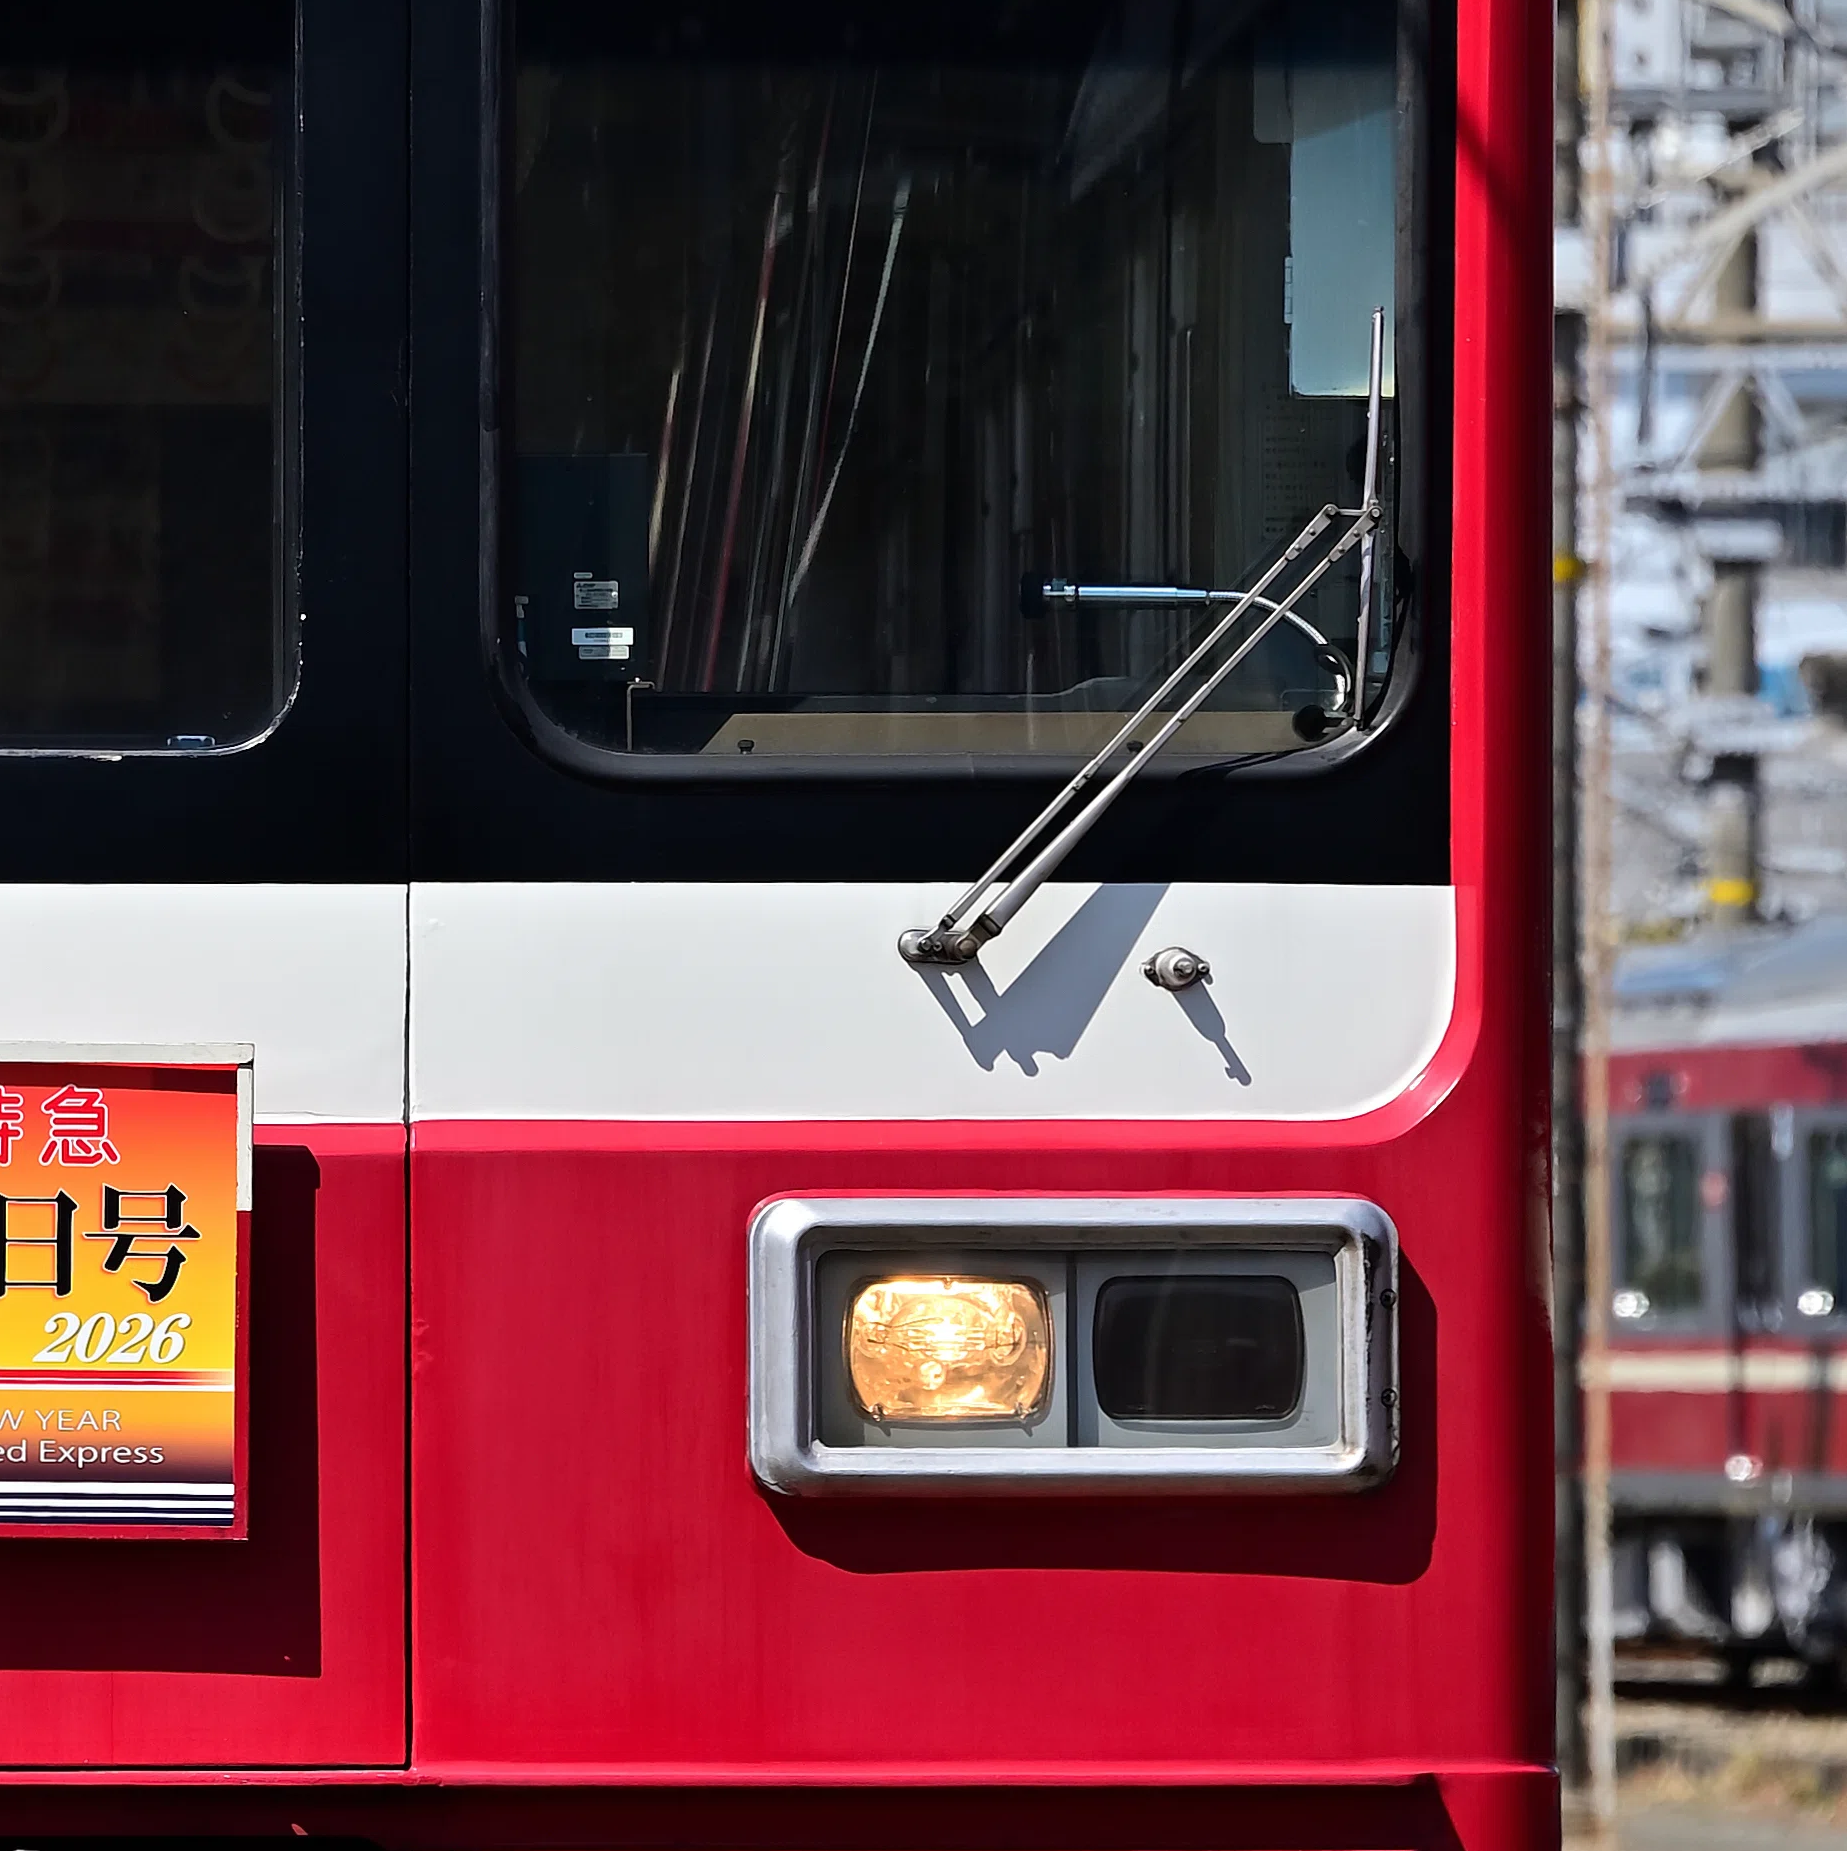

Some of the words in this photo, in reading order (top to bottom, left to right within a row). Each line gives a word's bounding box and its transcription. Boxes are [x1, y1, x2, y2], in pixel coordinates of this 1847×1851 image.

[32, 1312, 192, 1364] 2026
[35, 1408, 122, 1432] YEAR
[38, 1440, 165, 1468] Express
